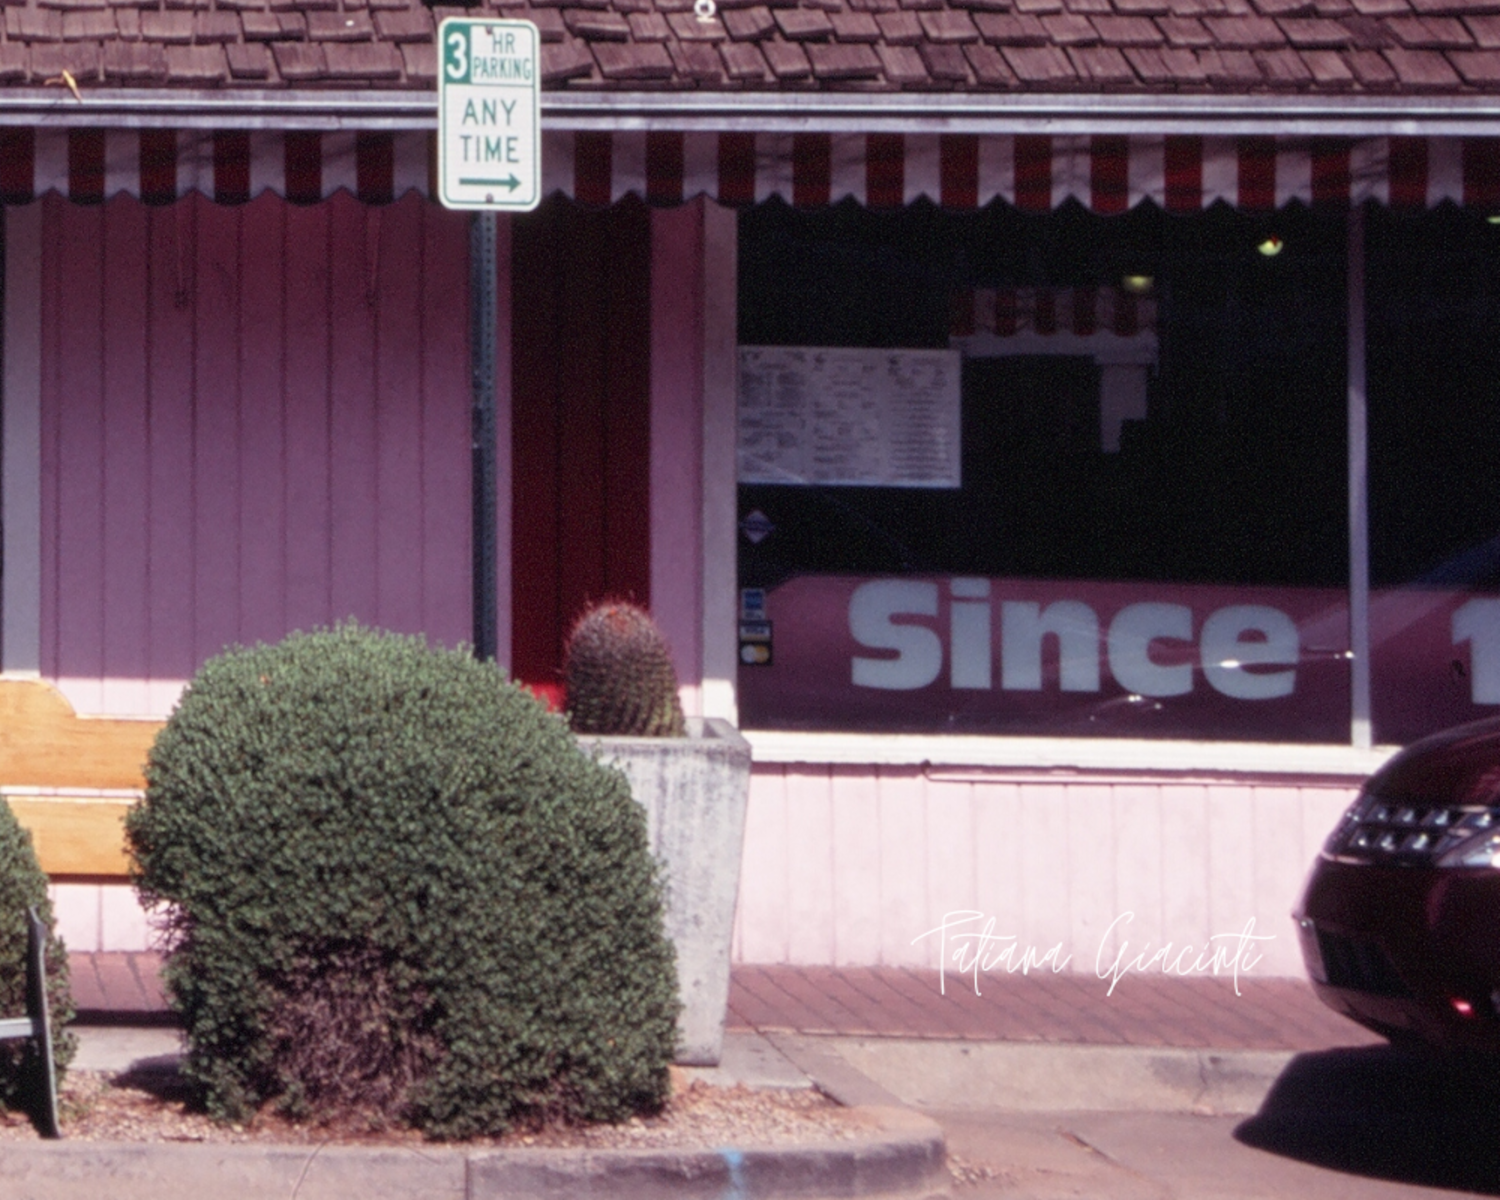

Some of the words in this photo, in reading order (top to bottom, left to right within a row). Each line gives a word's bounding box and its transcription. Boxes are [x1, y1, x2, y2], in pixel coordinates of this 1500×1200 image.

[446, 32, 468, 79] 3
[492, 33, 515, 54] HR
[473, 56, 531, 80] PARKING
[462, 98, 517, 126] ANY
[459, 135, 520, 163] TIME
[847, 576, 1300, 700] Since
